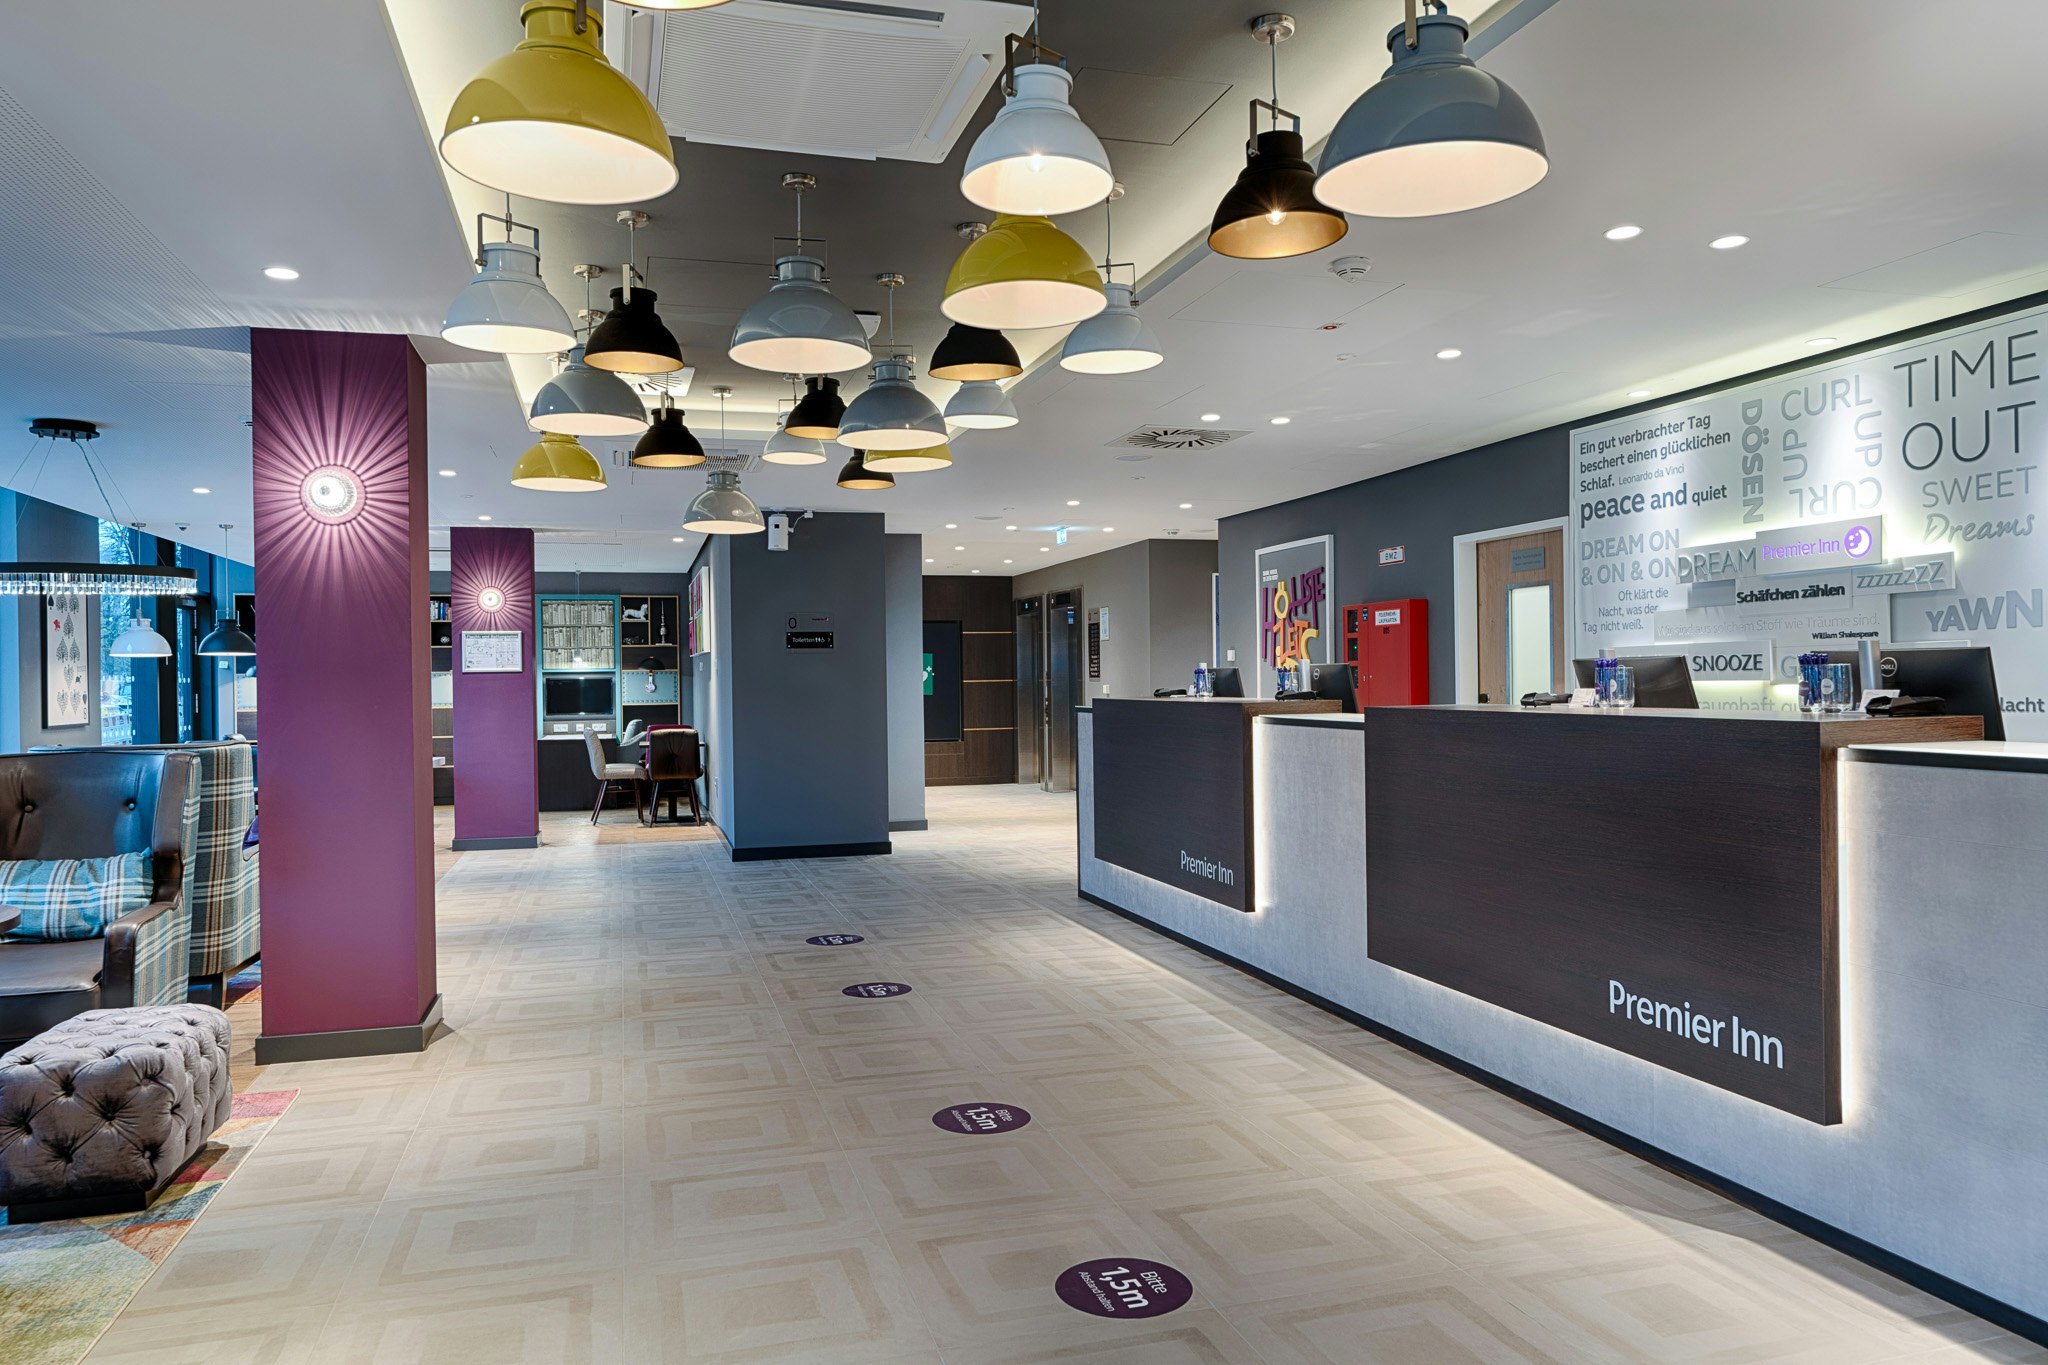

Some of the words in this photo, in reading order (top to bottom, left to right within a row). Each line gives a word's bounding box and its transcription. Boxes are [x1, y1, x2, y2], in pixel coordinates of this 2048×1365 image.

[1894, 330, 2040, 408] TIME
[1781, 374, 1873, 421] CURL
[1580, 442, 1596, 455] Ein
[1598, 436, 1616, 454] gut
[1618, 420, 1685, 446] verbrachter
[1688, 415, 1711, 430] Tag
[1580, 454, 1625, 474] beschert
[1627, 448, 1657, 464] einen
[1660, 431, 1731, 460] glücklichen
[1854, 410, 1882, 467] UP
[1902, 400, 2036, 470] OUT
[1742, 398, 1769, 524] DÖSEN
[1783, 429, 1808, 482] UP
[1580, 474, 1615, 493] Schlaf.
[1619, 470, 1653, 486] Leonardo
[1654, 467, 1664, 478] da
[1665, 464, 1685, 476] Vinci
[1922, 465, 2038, 508] SWEET
[1580, 492, 1645, 529] peace
[1650, 483, 1687, 510] and
[1692, 484, 1727, 506] quiet
[1789, 477, 1883, 518] CURL
[1581, 533, 1644, 561] DREAM
[1649, 528, 1680, 552] ON
[1923, 513, 2035, 543] Dreams
[1678, 547, 1757, 578] DREAM
[1763, 541, 1816, 561] Premier
[1818, 538, 1840, 554] Inn
[1581, 566, 1593, 586] &
[1597, 562, 1625, 585] ON
[1630, 560, 1644, 581] &
[1598, 607, 1624, 618] Nacht,
[1626, 605, 1642, 616] was
[1644, 604, 1659, 614] der
[1618, 590, 1633, 601] Oft
[1634, 588, 1653, 599] klärt
[1655, 587, 1669, 598] die
[1736, 586, 1799, 605] Schäfchen
[1801, 583, 1845, 599] zählen
[1925, 588, 2044, 632] YAWN
[1583, 622, 1598, 635] Tag
[1600, 621, 1620, 632] nicht
[1622, 619, 1644, 631] weiß.
[1756, 618, 1782, 631] Stoff
[1784, 619, 1803, 630] wie
[1807, 615, 1850, 628] Träume
[1812, 631, 1837, 640] William
[1838, 630, 1880, 640] Shakespeare
[1692, 653, 1764, 672] SNOOZE
[1181, 850, 1217, 880] Premier
[1218, 861, 1234, 886] Inn
[1609, 979, 1726, 1048] Premier
[1732, 1015, 1784, 1069] Inn
[964, 1106, 998, 1130] 1,5m
[1078, 1271, 1101, 1295] Abstand
[1096, 1291, 1115, 1312] halten
[1099, 1266, 1149, 1309] 1,5m
[1140, 1271, 1168, 1294] Bitte
